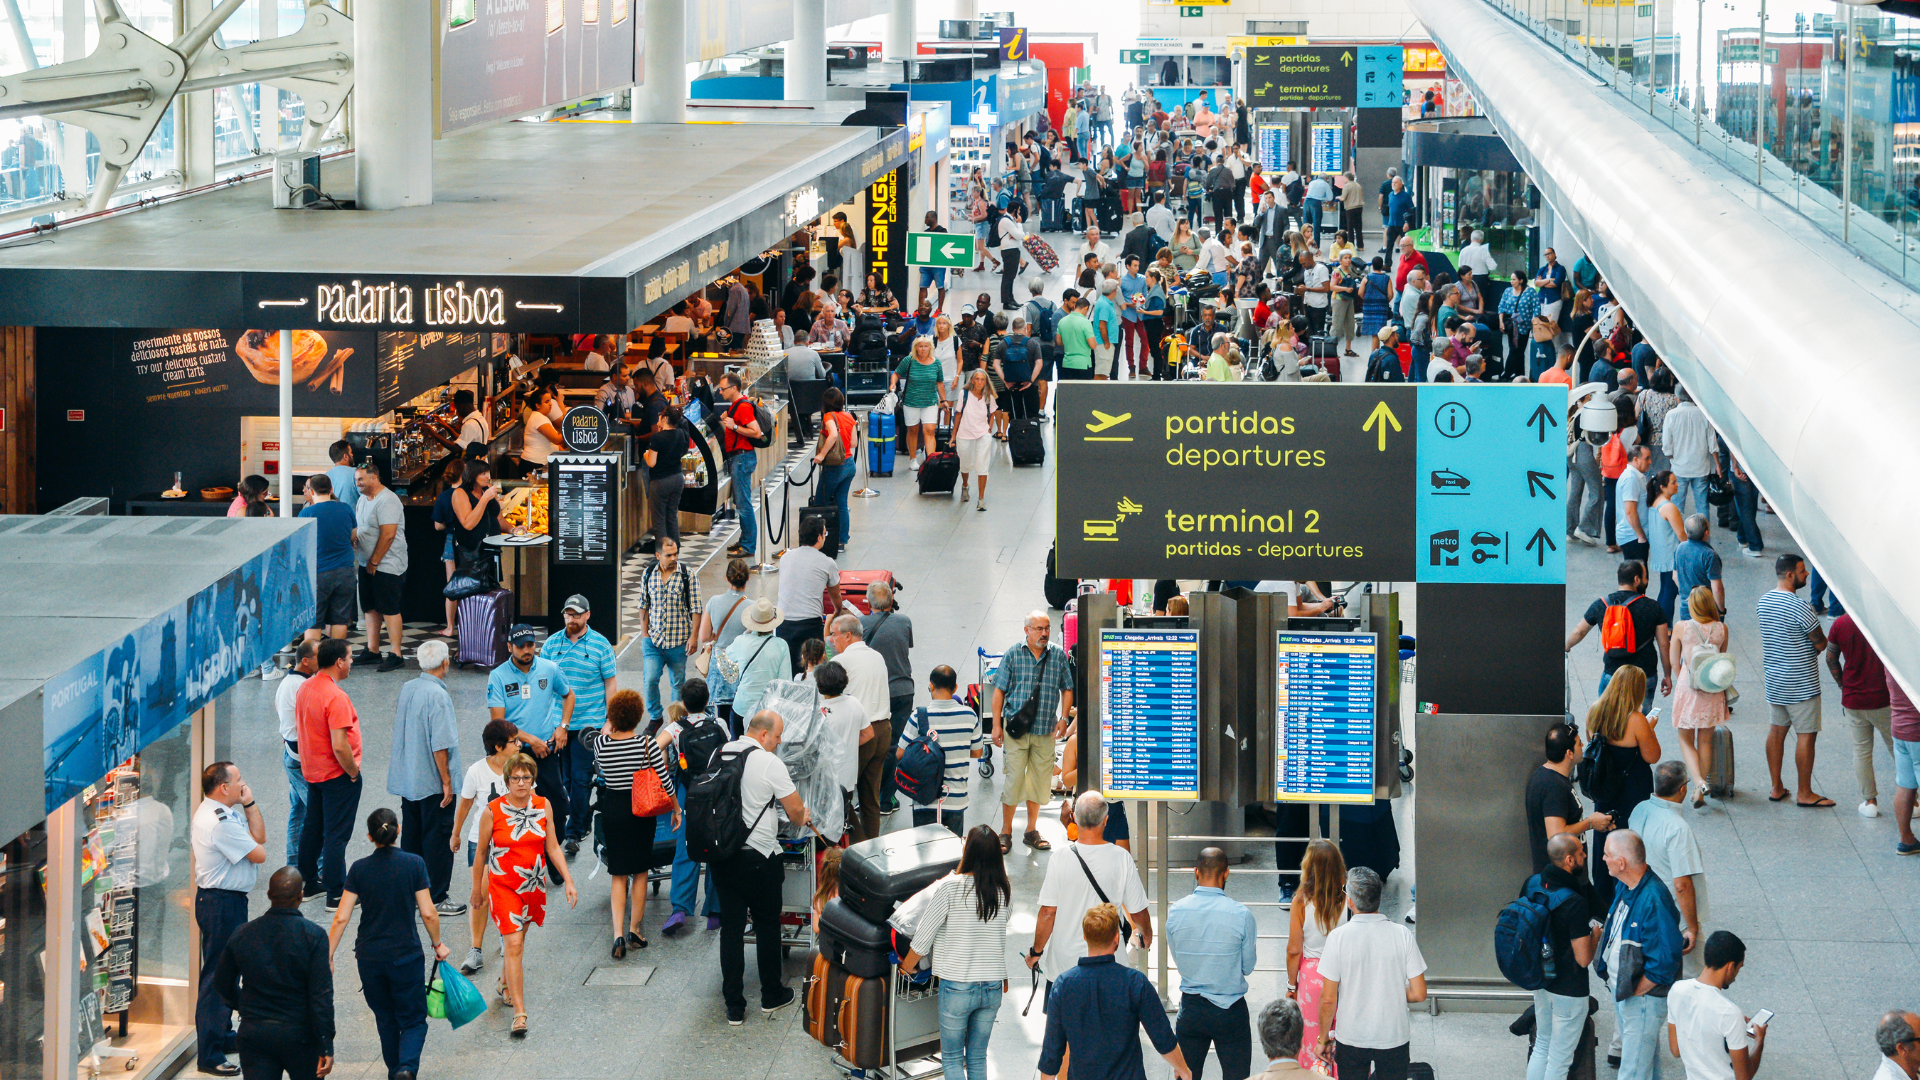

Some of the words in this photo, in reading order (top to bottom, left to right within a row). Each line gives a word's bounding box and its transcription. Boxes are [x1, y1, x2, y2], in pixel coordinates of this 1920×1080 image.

[1280, 54, 1320, 64] partidas
[1280, 65, 1330, 74] departures
[1279, 85, 1320, 93] terminal
[183, 334, 192, 342] os
[193, 328, 220, 340] nossos
[131, 348, 169, 362] deliciosos
[170, 342, 197, 356] pastéis
[199, 341, 208, 351] de
[210, 338, 230, 350] nata.
[150, 363, 163, 373] our
[165, 356, 197, 371] delicious
[199, 351, 226, 365] custard
[163, 370, 185, 382] cream
[187, 366, 206, 377] tarts.
[1166, 410, 1295, 440] partidas
[1166, 443, 1326, 471] departures
[1165, 508, 1293, 533] terminal
[1304, 510, 1320, 533] 2
[1166, 541, 1241, 558] partidas
[1258, 541, 1364, 560] departures
[1432, 537, 1457, 545] metro
[51, 670, 99, 711] PORTUGAL
